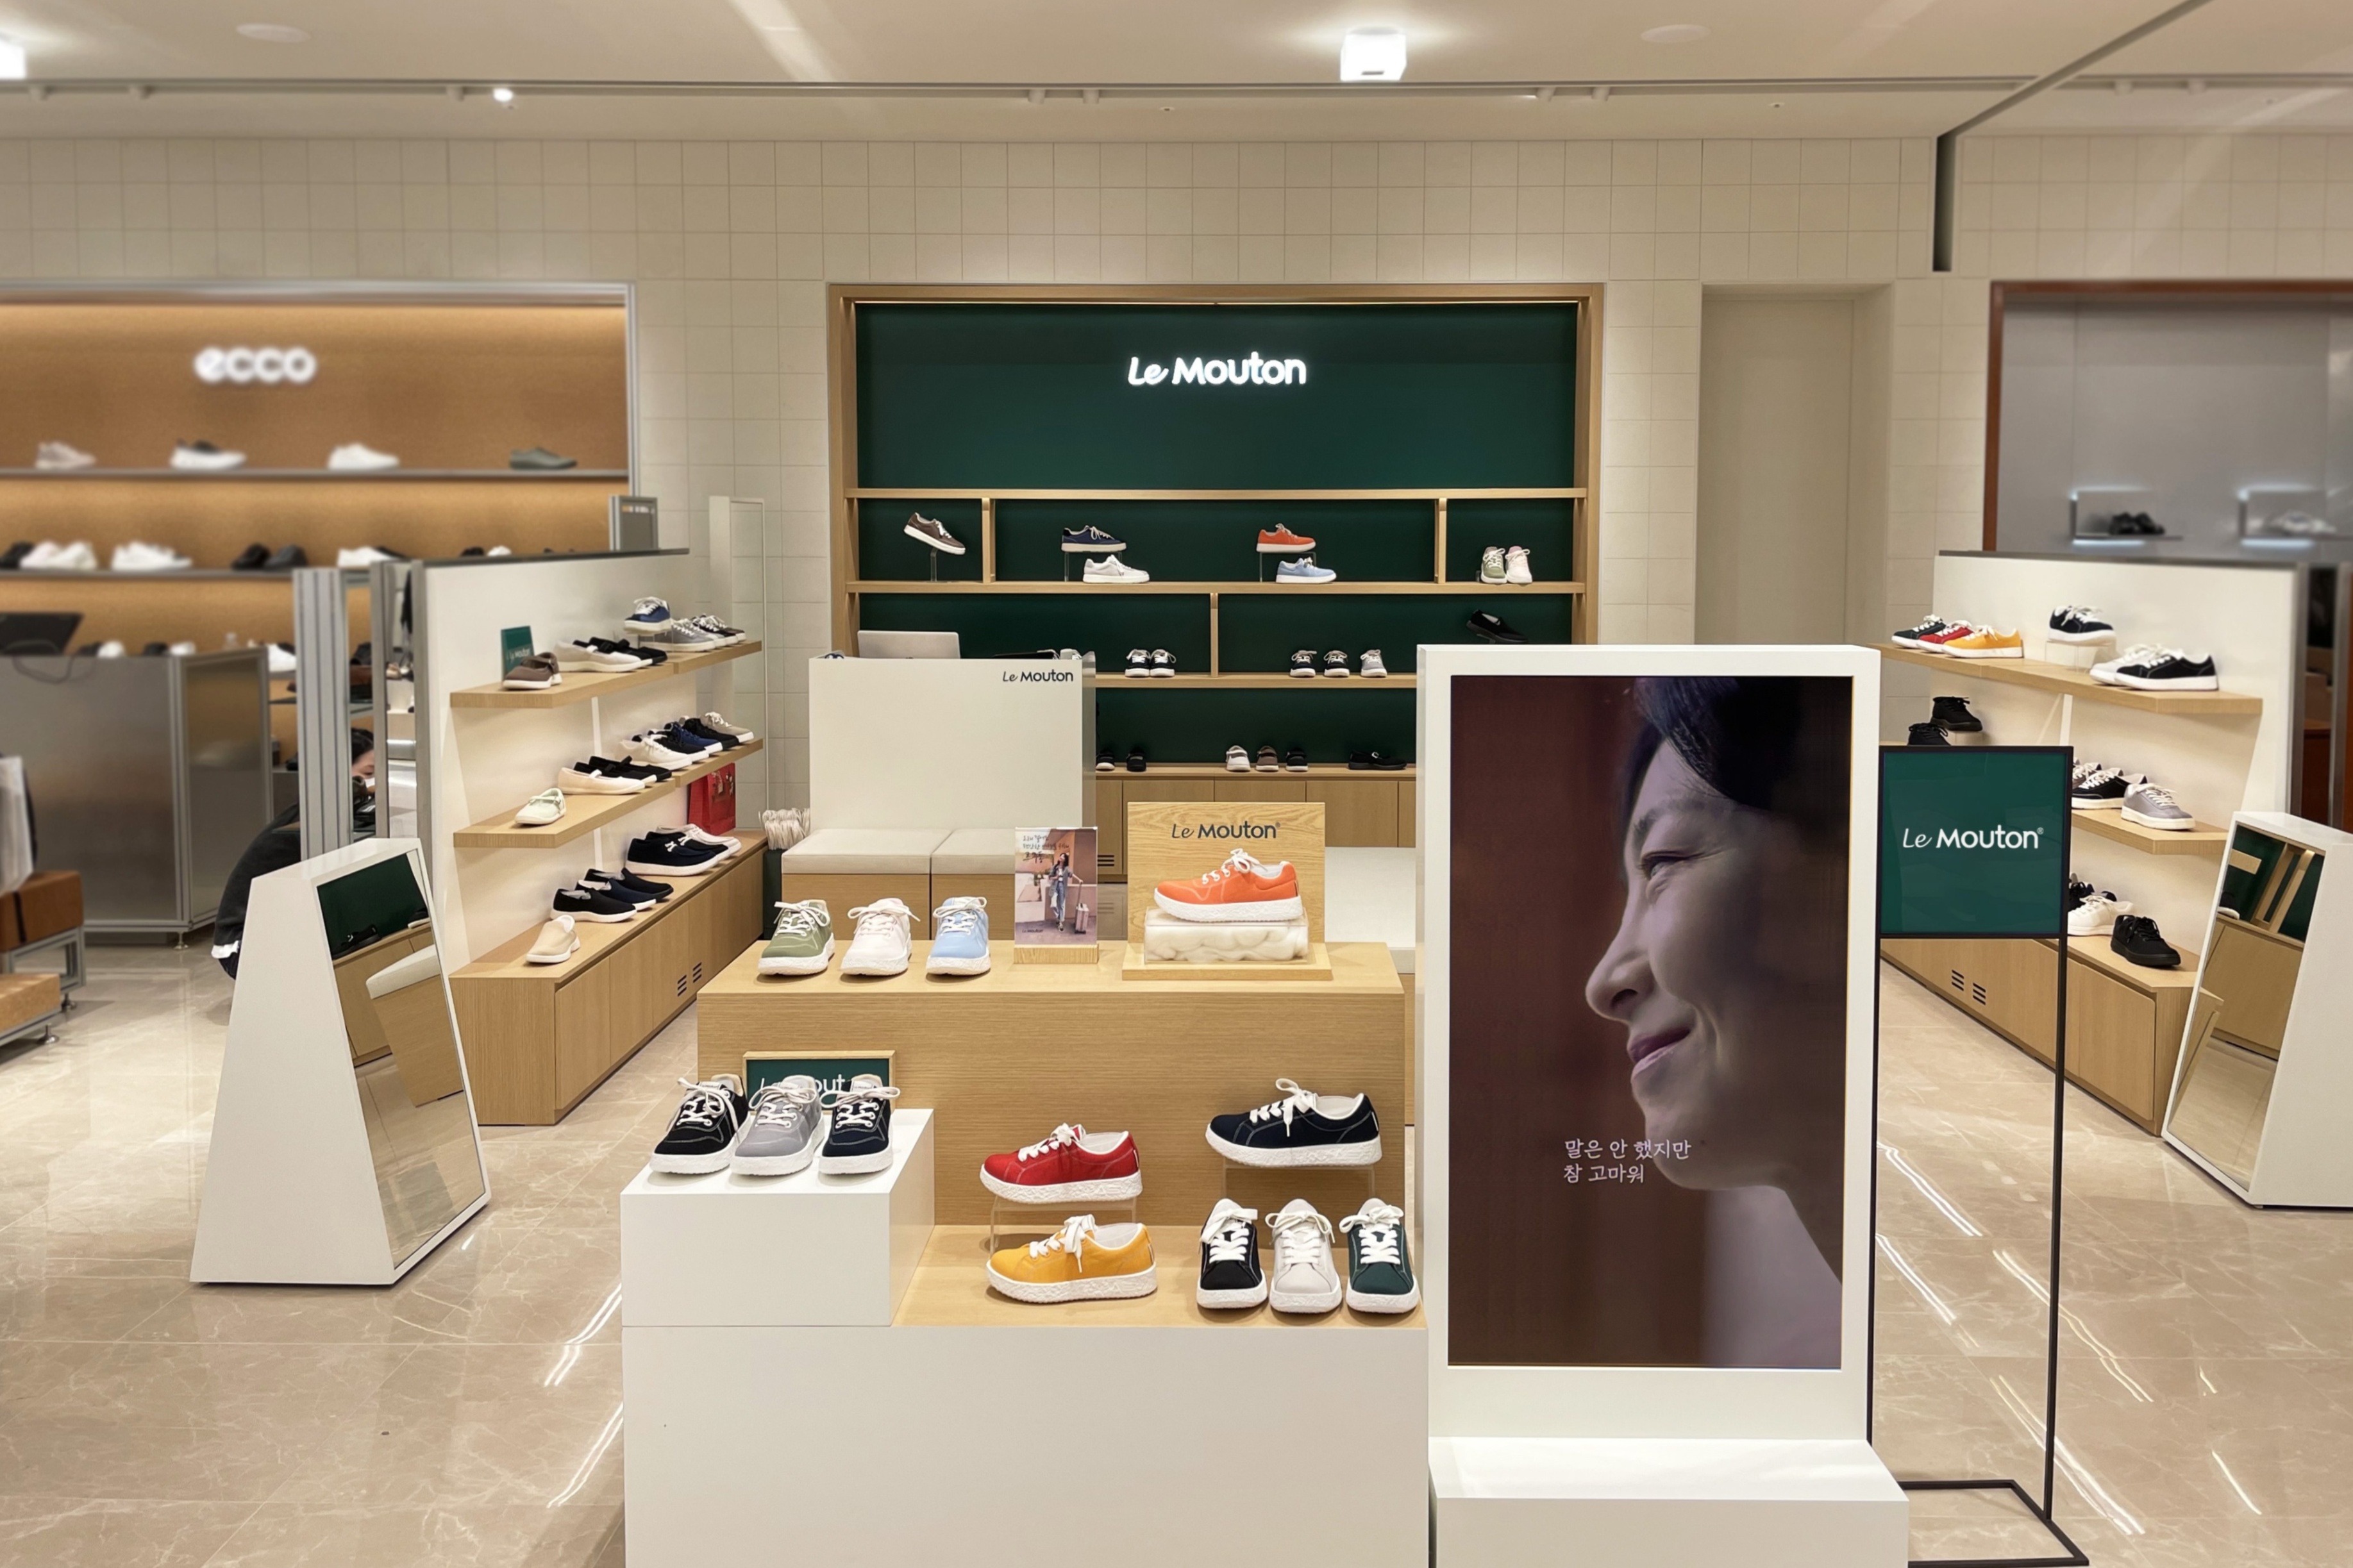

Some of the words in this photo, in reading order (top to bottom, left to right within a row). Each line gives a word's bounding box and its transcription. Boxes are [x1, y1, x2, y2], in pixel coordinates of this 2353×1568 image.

[195, 347, 317, 383] ecco
[1128, 356, 1169, 385] Le
[1172, 351, 1307, 385] Mouton
[1003, 671, 1018, 681] Le
[1020, 669, 1073, 681] Mouton
[1171, 824, 1194, 838] Le
[1903, 828, 1932, 848] Le
[1564, 1138, 1603, 1159] 말은
[1609, 1138, 1629, 1159] 안
[1633, 1139, 1692, 1160] 했지만
[1564, 1163, 1583, 1183] 참
[1587, 1163, 1645, 1183] 고마워
